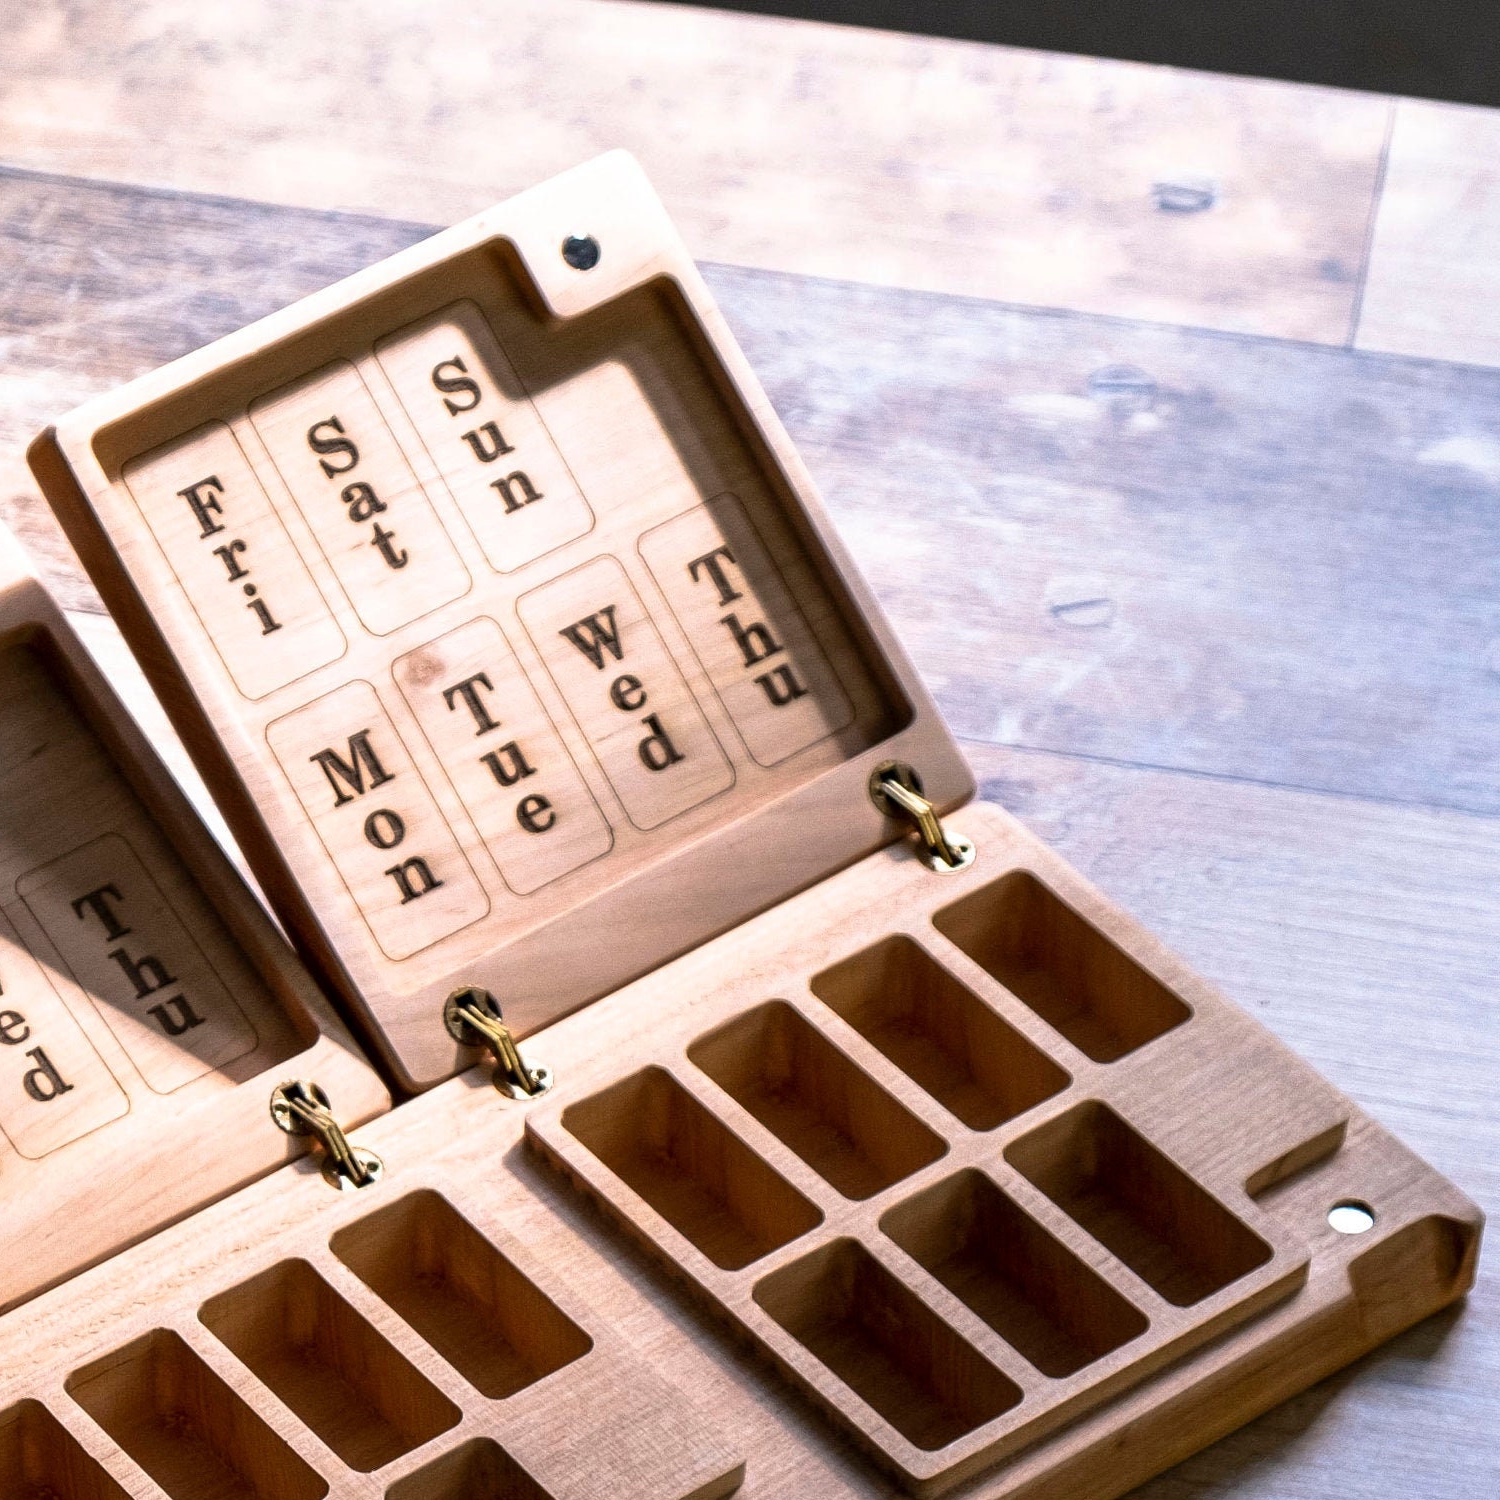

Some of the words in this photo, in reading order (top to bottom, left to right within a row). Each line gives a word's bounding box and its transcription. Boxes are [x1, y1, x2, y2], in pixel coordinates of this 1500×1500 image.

[306, 415, 409, 571] Sat
[431, 354, 544, 515] Sun
[176, 475, 283, 636] Fri
[687, 544, 808, 709] Thu
[442, 671, 558, 835] Tue
[558, 604, 686, 773] Wed
[309, 727, 445, 906] Mon
[70, 882, 207, 1038] Thu
